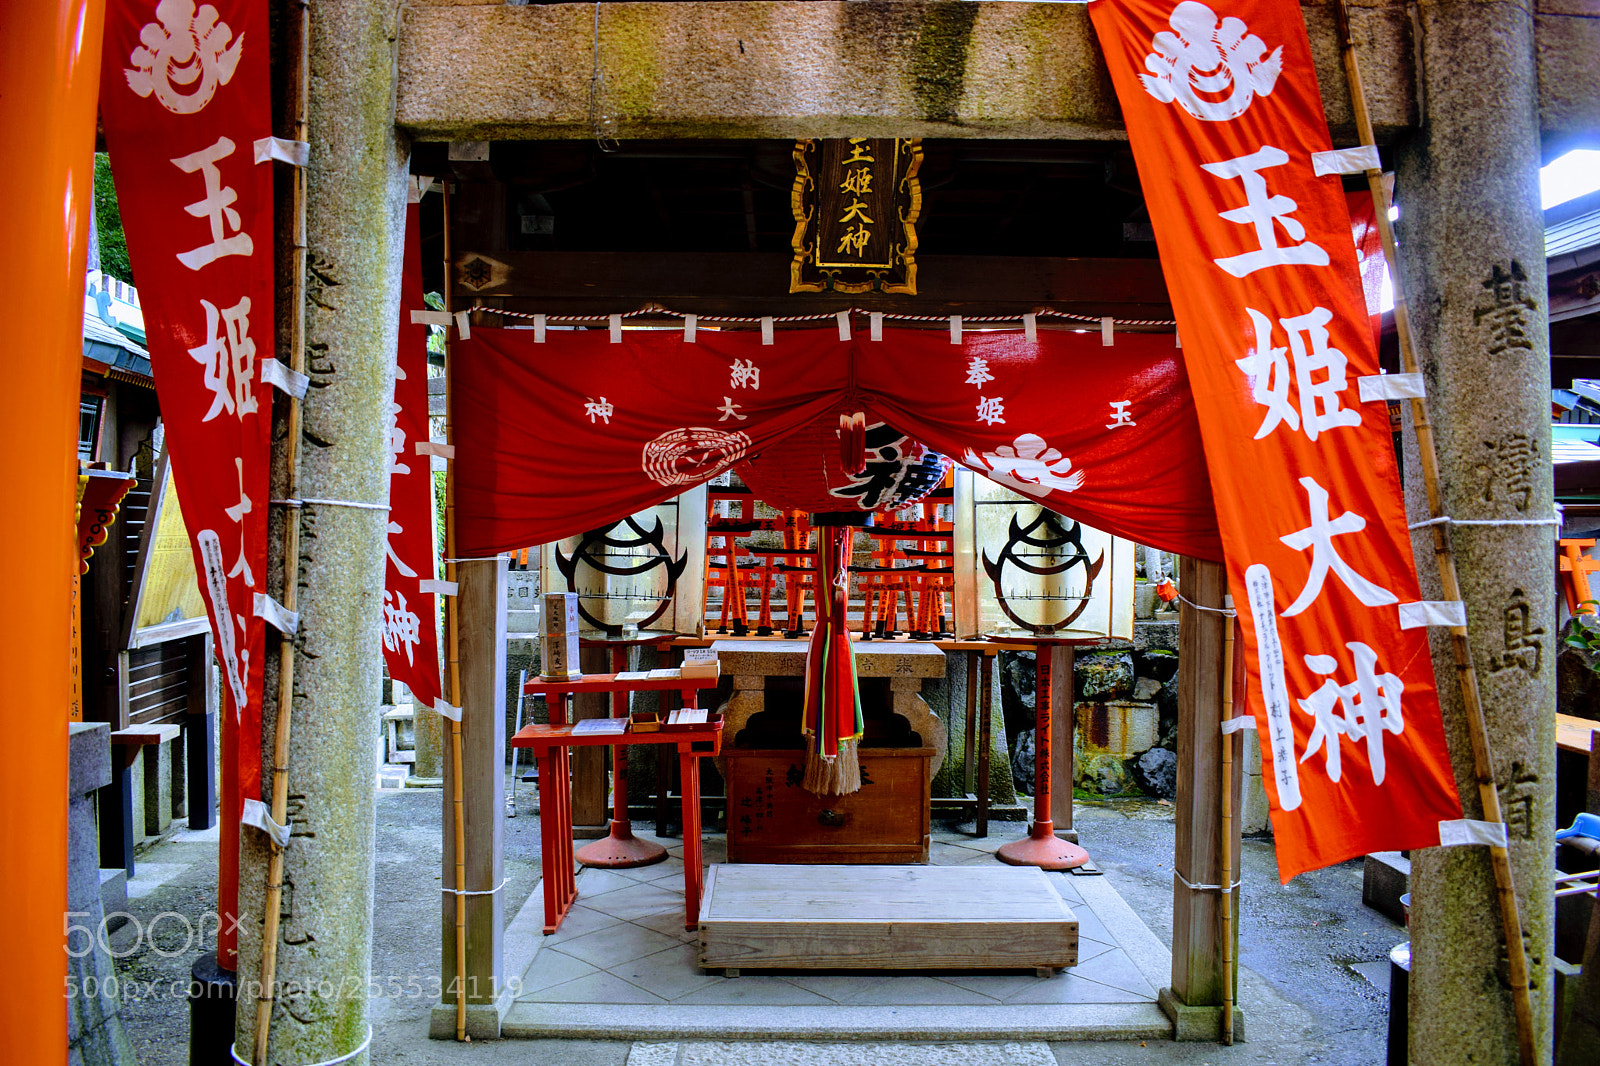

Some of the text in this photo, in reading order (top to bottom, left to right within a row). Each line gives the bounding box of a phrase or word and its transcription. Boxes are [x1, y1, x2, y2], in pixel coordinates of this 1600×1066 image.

[836, 137, 875, 258] 玉姫大神
[584, 396, 1137, 430] 玉 姫 大 神
[729, 357, 995, 391] 奉 納
[1200, 145, 1405, 786] 玉姫大神
[1040, 664, 1051, 796] 日本工事ライト株式会社
